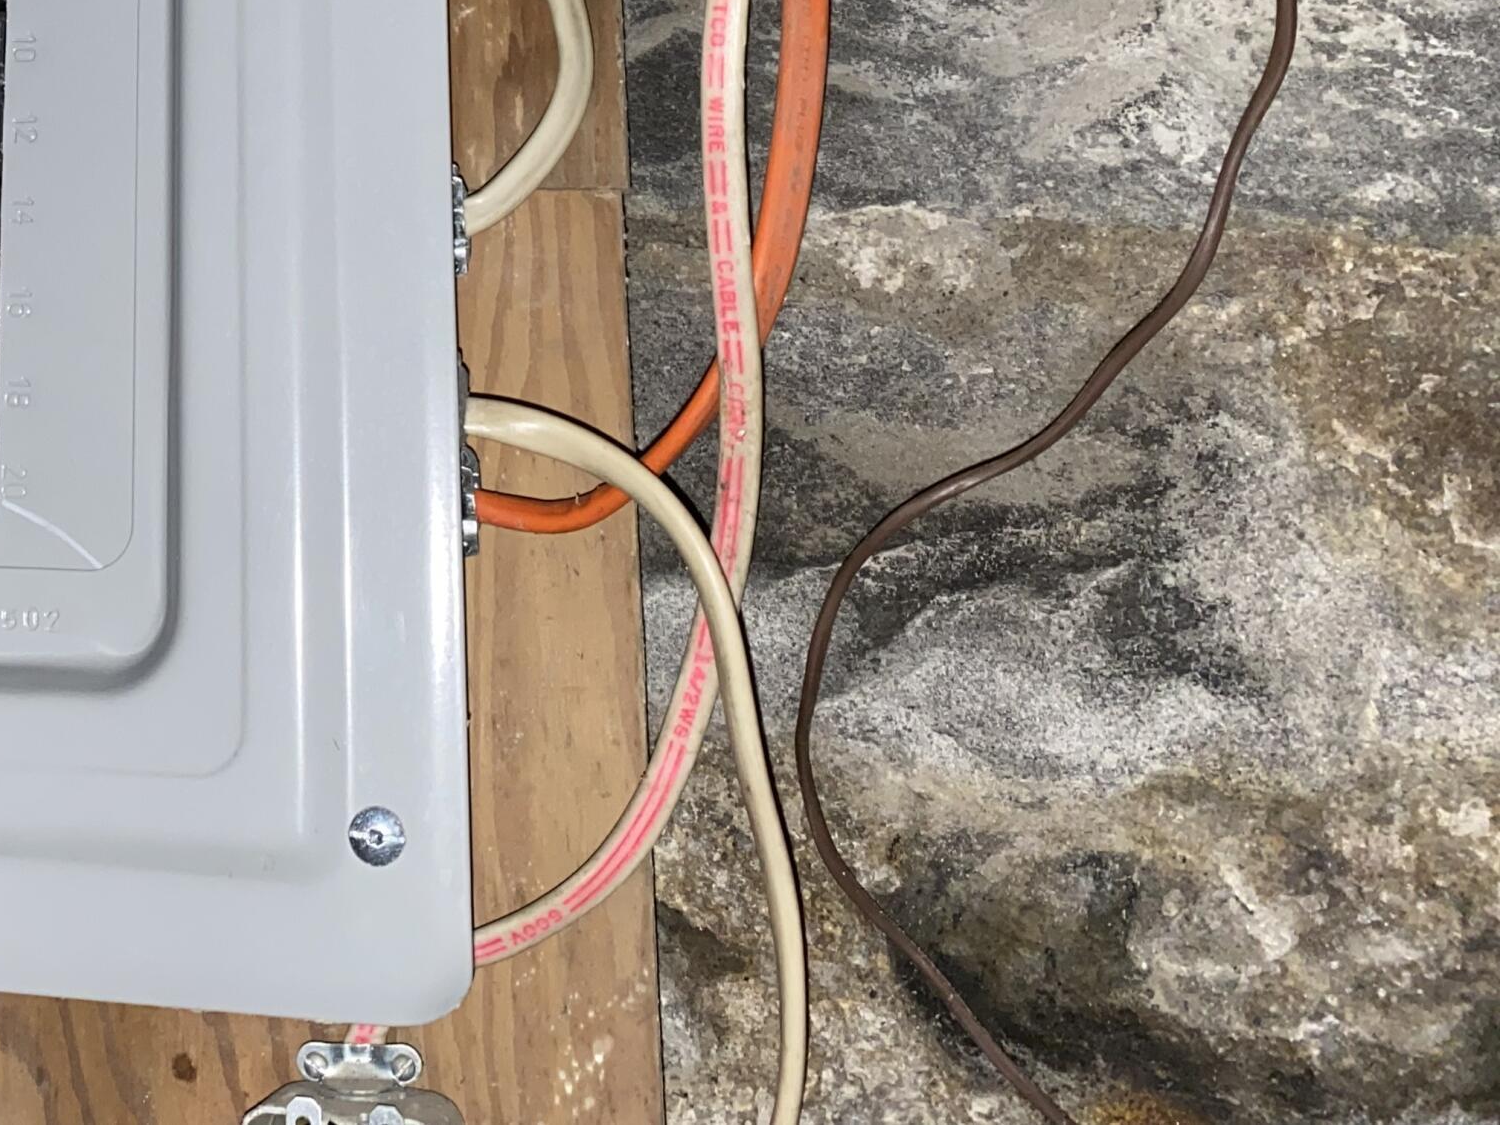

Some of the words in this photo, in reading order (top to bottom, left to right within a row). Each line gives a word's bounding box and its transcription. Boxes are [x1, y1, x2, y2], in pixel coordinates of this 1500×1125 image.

[12, 112, 38, 145] 12
[707, 96, 726, 153] WIRE
[716, 259, 739, 334] CABLE
[510, 909, 563, 946] 600V
